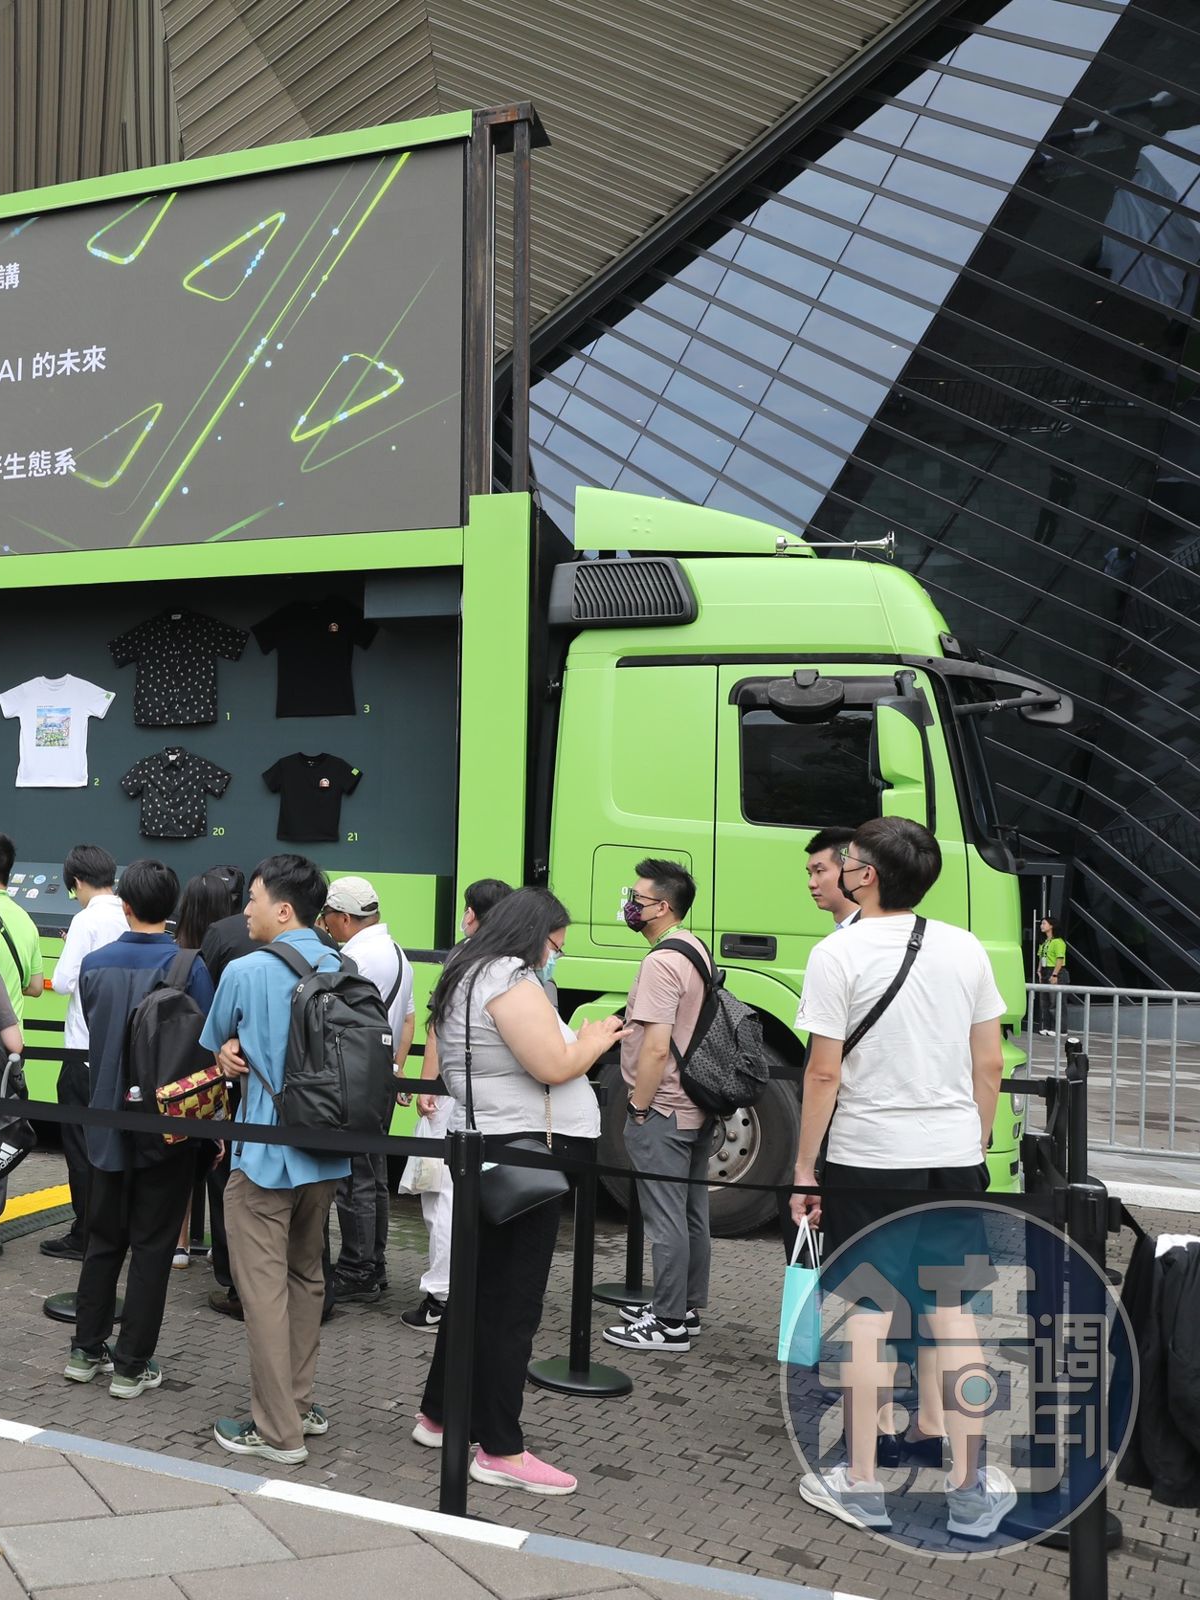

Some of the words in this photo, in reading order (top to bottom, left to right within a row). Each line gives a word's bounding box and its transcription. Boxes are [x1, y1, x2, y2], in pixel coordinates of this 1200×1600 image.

[32, 344, 107, 380] 的未來
[212, 827, 225, 836] 20
[347, 832, 358, 842] 21
